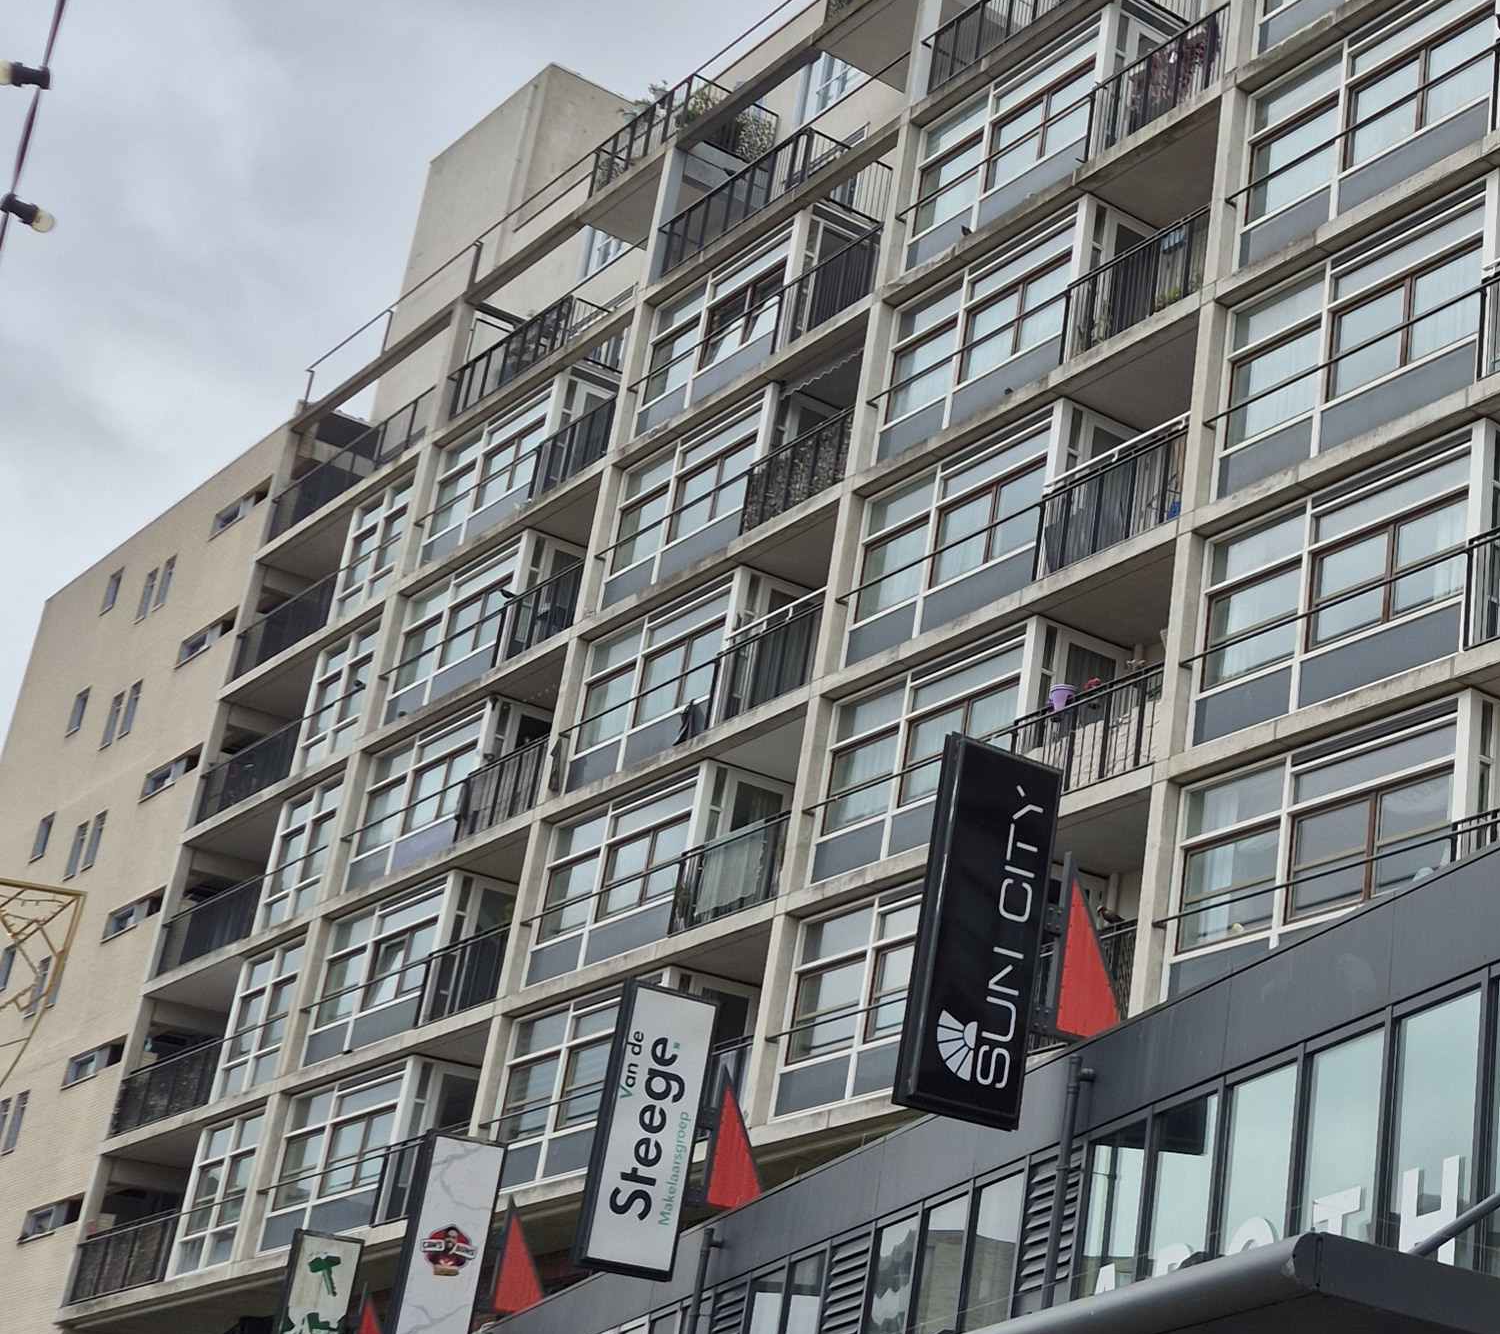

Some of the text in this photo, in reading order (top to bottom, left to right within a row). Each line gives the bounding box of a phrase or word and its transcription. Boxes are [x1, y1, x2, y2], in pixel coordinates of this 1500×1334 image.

[976, 785, 1043, 1090] SUN CITY
[609, 1036, 685, 1221] Steege
[620, 1030, 644, 1099] Van de
[658, 1111, 691, 1226] Makelaarsgroep
